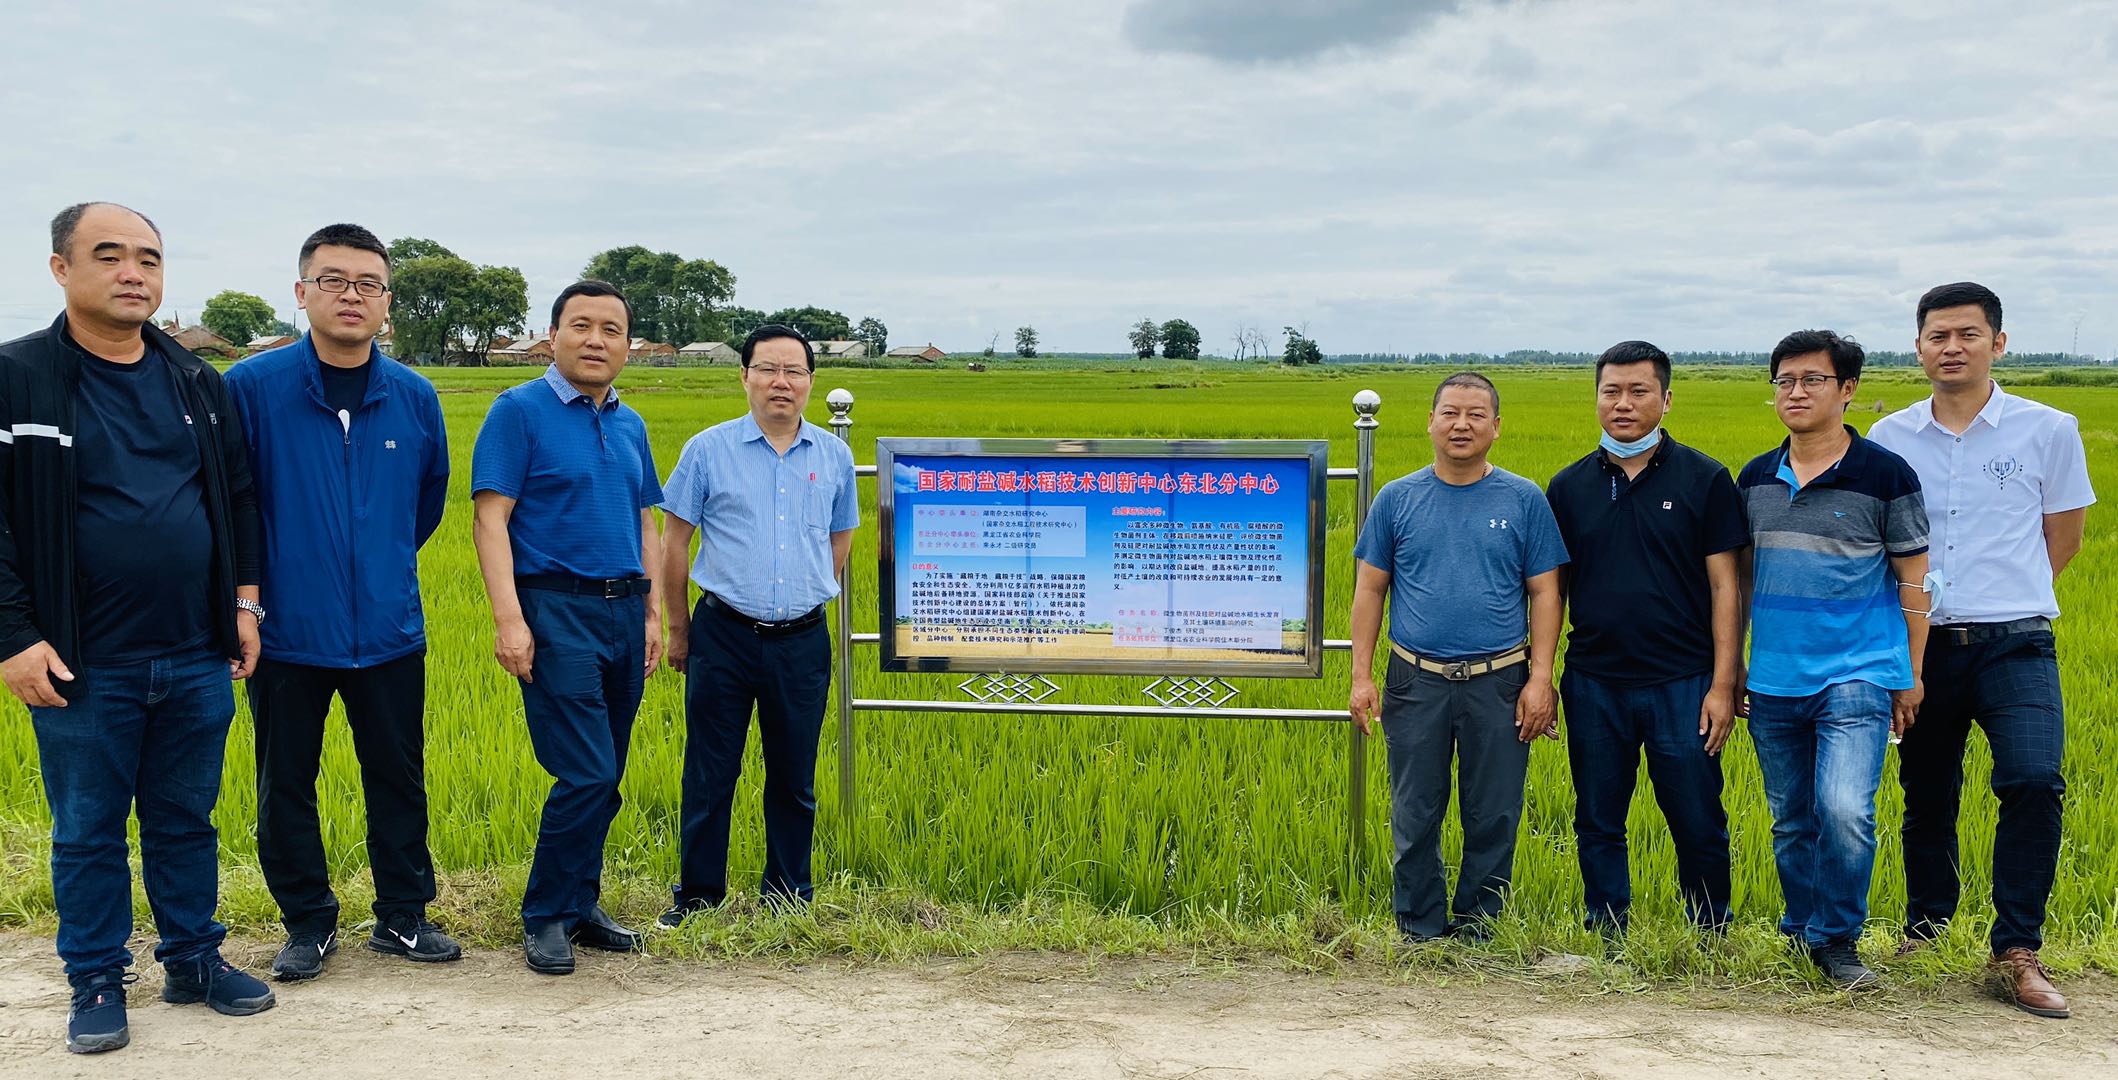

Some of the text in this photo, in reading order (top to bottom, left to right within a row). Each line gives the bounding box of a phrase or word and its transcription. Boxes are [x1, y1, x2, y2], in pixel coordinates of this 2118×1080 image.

[917, 470, 1280, 495] 国家耐盐碱水稻技术创新中心东北分中心
